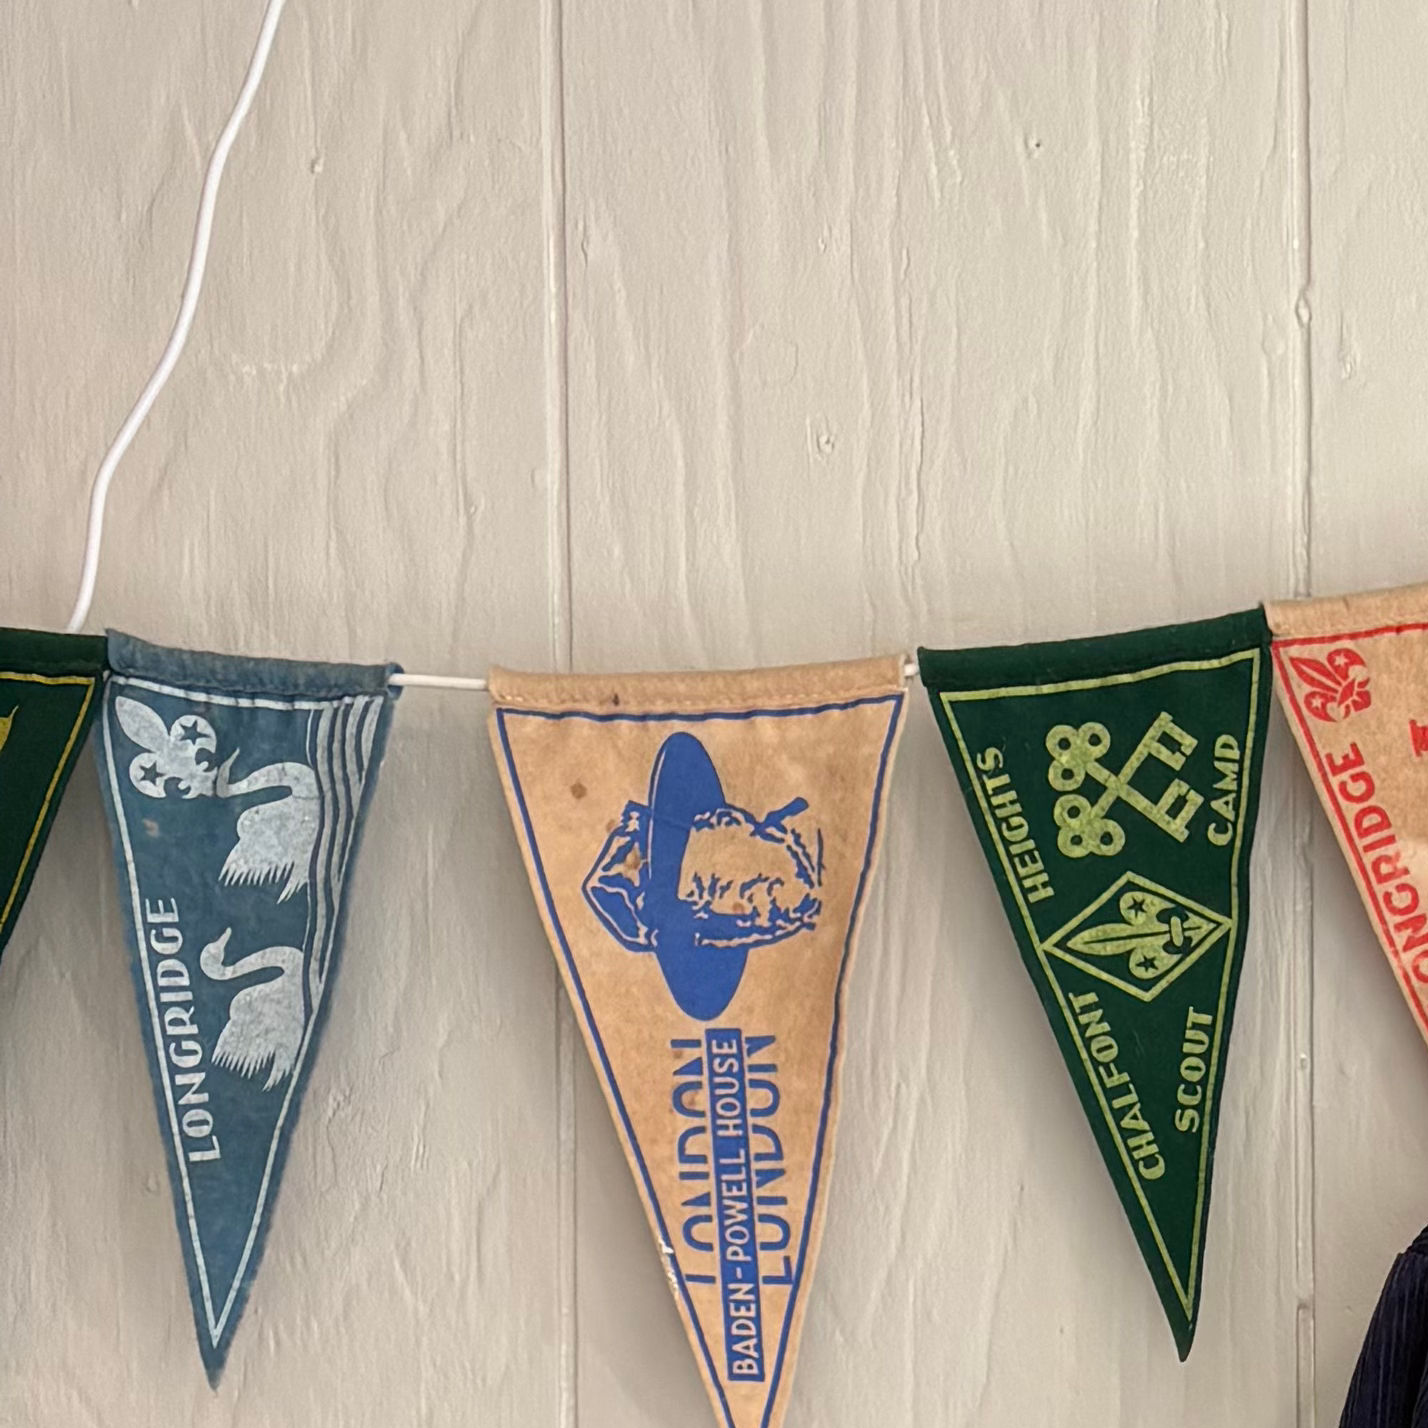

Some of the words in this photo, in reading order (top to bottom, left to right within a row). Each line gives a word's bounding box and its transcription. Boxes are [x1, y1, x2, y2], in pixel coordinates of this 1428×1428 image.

[976, 746, 1055, 904] HEIGHTS
[1174, 1005, 1214, 1134] SCOUT
[1207, 733, 1240, 847] CAMP
[145, 897, 221, 1162] LONGRIDGE
[711, 1036, 744, 1138] HOUSE
[1067, 991, 1166, 1180] CHALFONT
